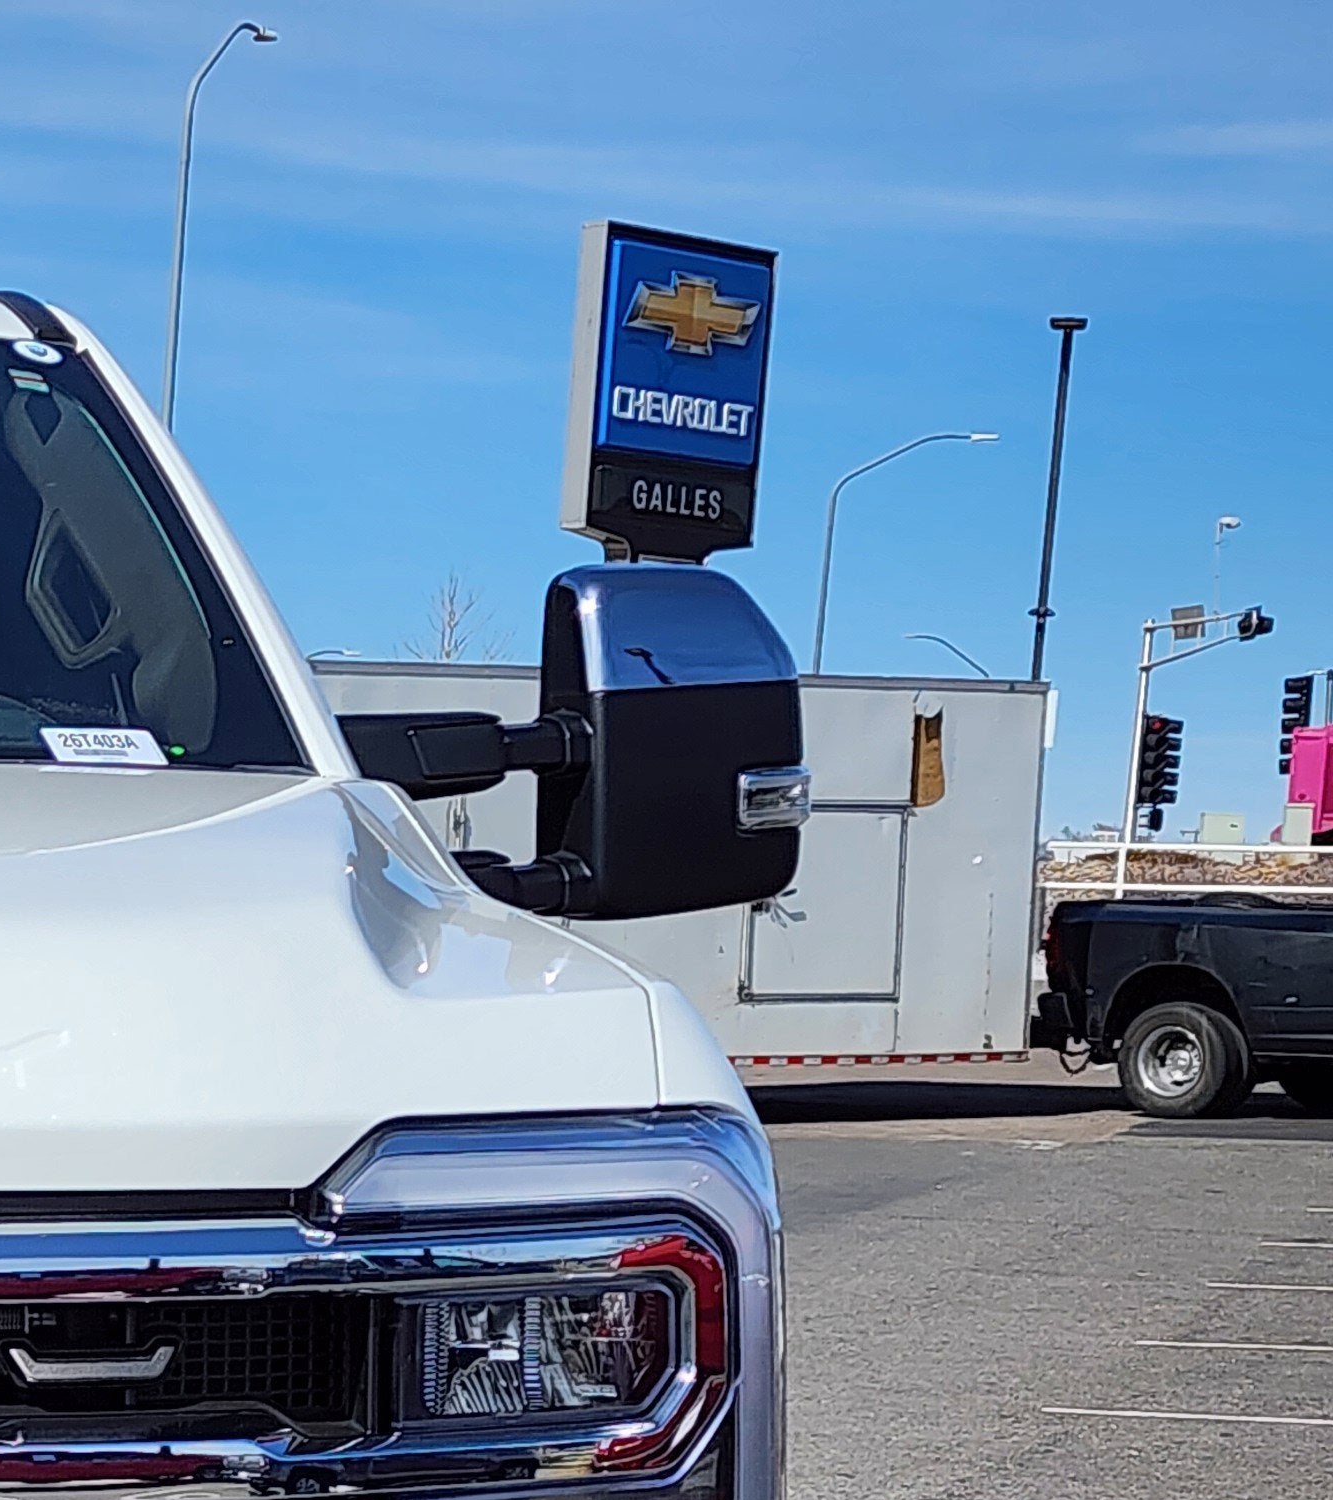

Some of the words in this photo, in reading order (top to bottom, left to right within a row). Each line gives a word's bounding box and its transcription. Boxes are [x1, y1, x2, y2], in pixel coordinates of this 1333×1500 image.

[612, 384, 754, 437] CHEVROLET
[633, 478, 723, 520] GALLES
[57, 733, 139, 751] 26T403A
